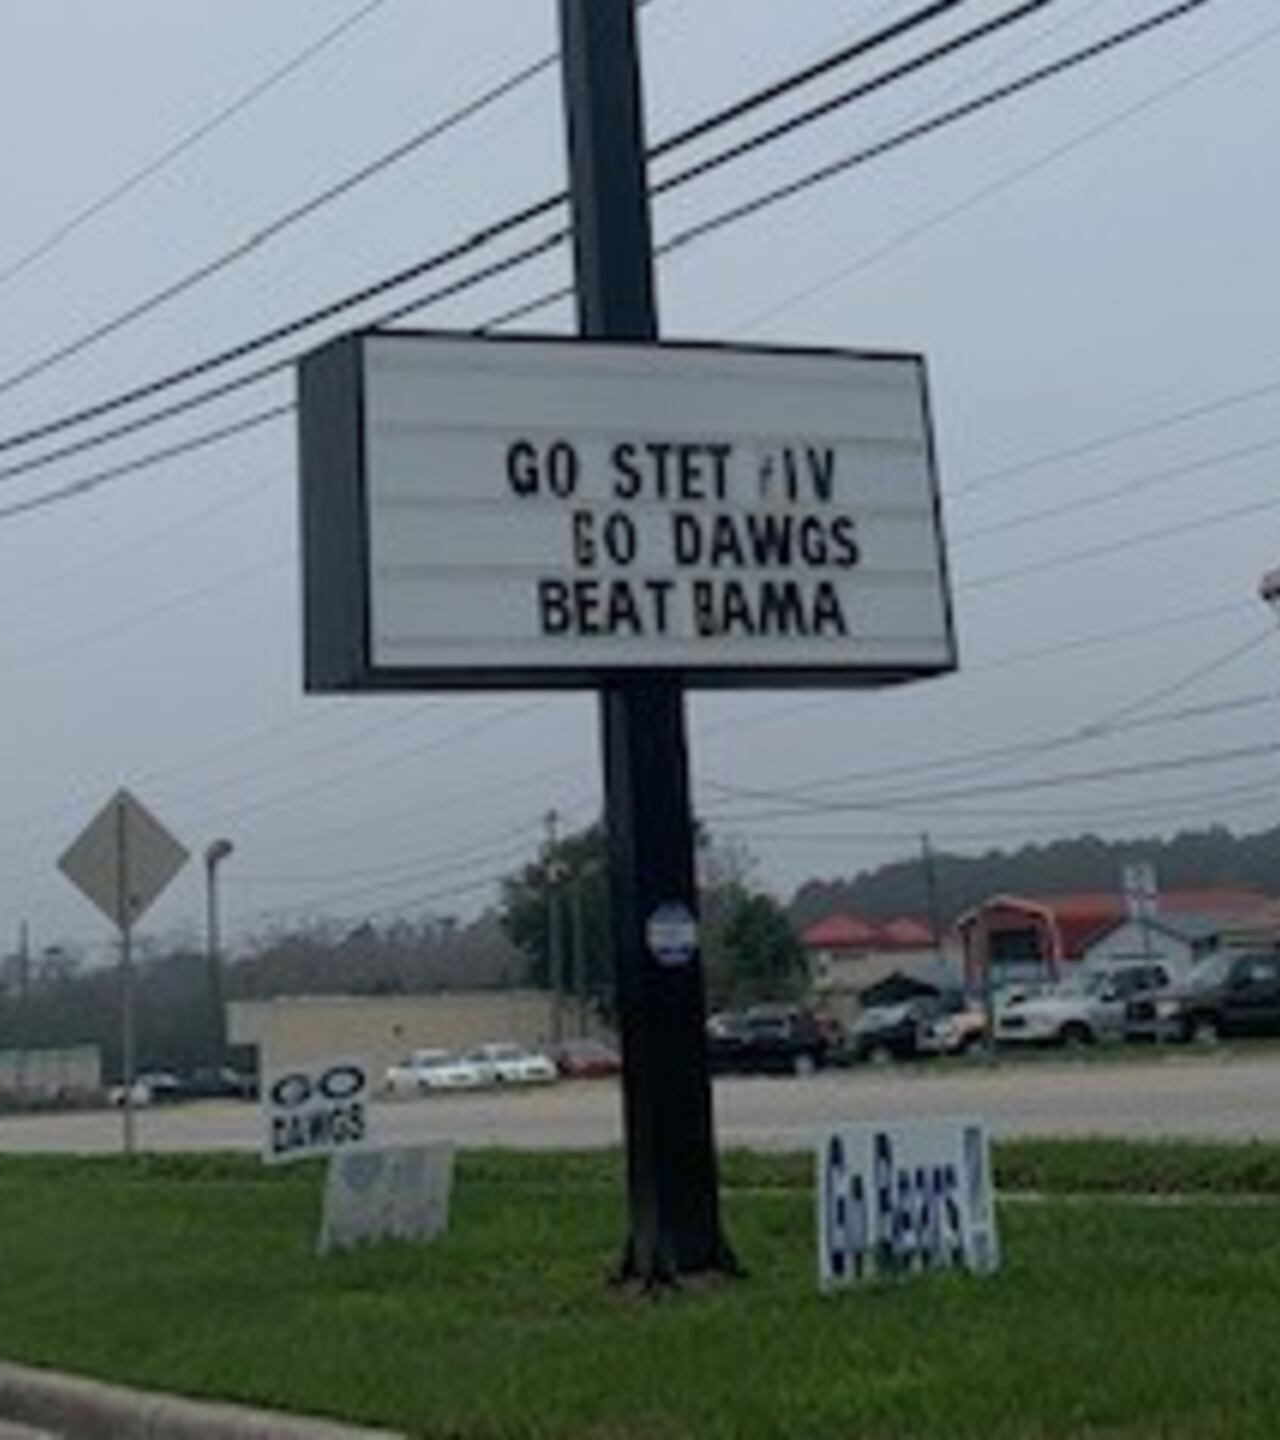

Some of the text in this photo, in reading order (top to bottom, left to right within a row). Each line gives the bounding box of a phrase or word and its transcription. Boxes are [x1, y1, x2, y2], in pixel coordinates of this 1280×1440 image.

[507, 440, 579, 499] GO
[613, 442, 731, 501] STET
[573, 510, 860, 569] GO DAWGS
[538, 579, 847, 637] BEAT BAMA
